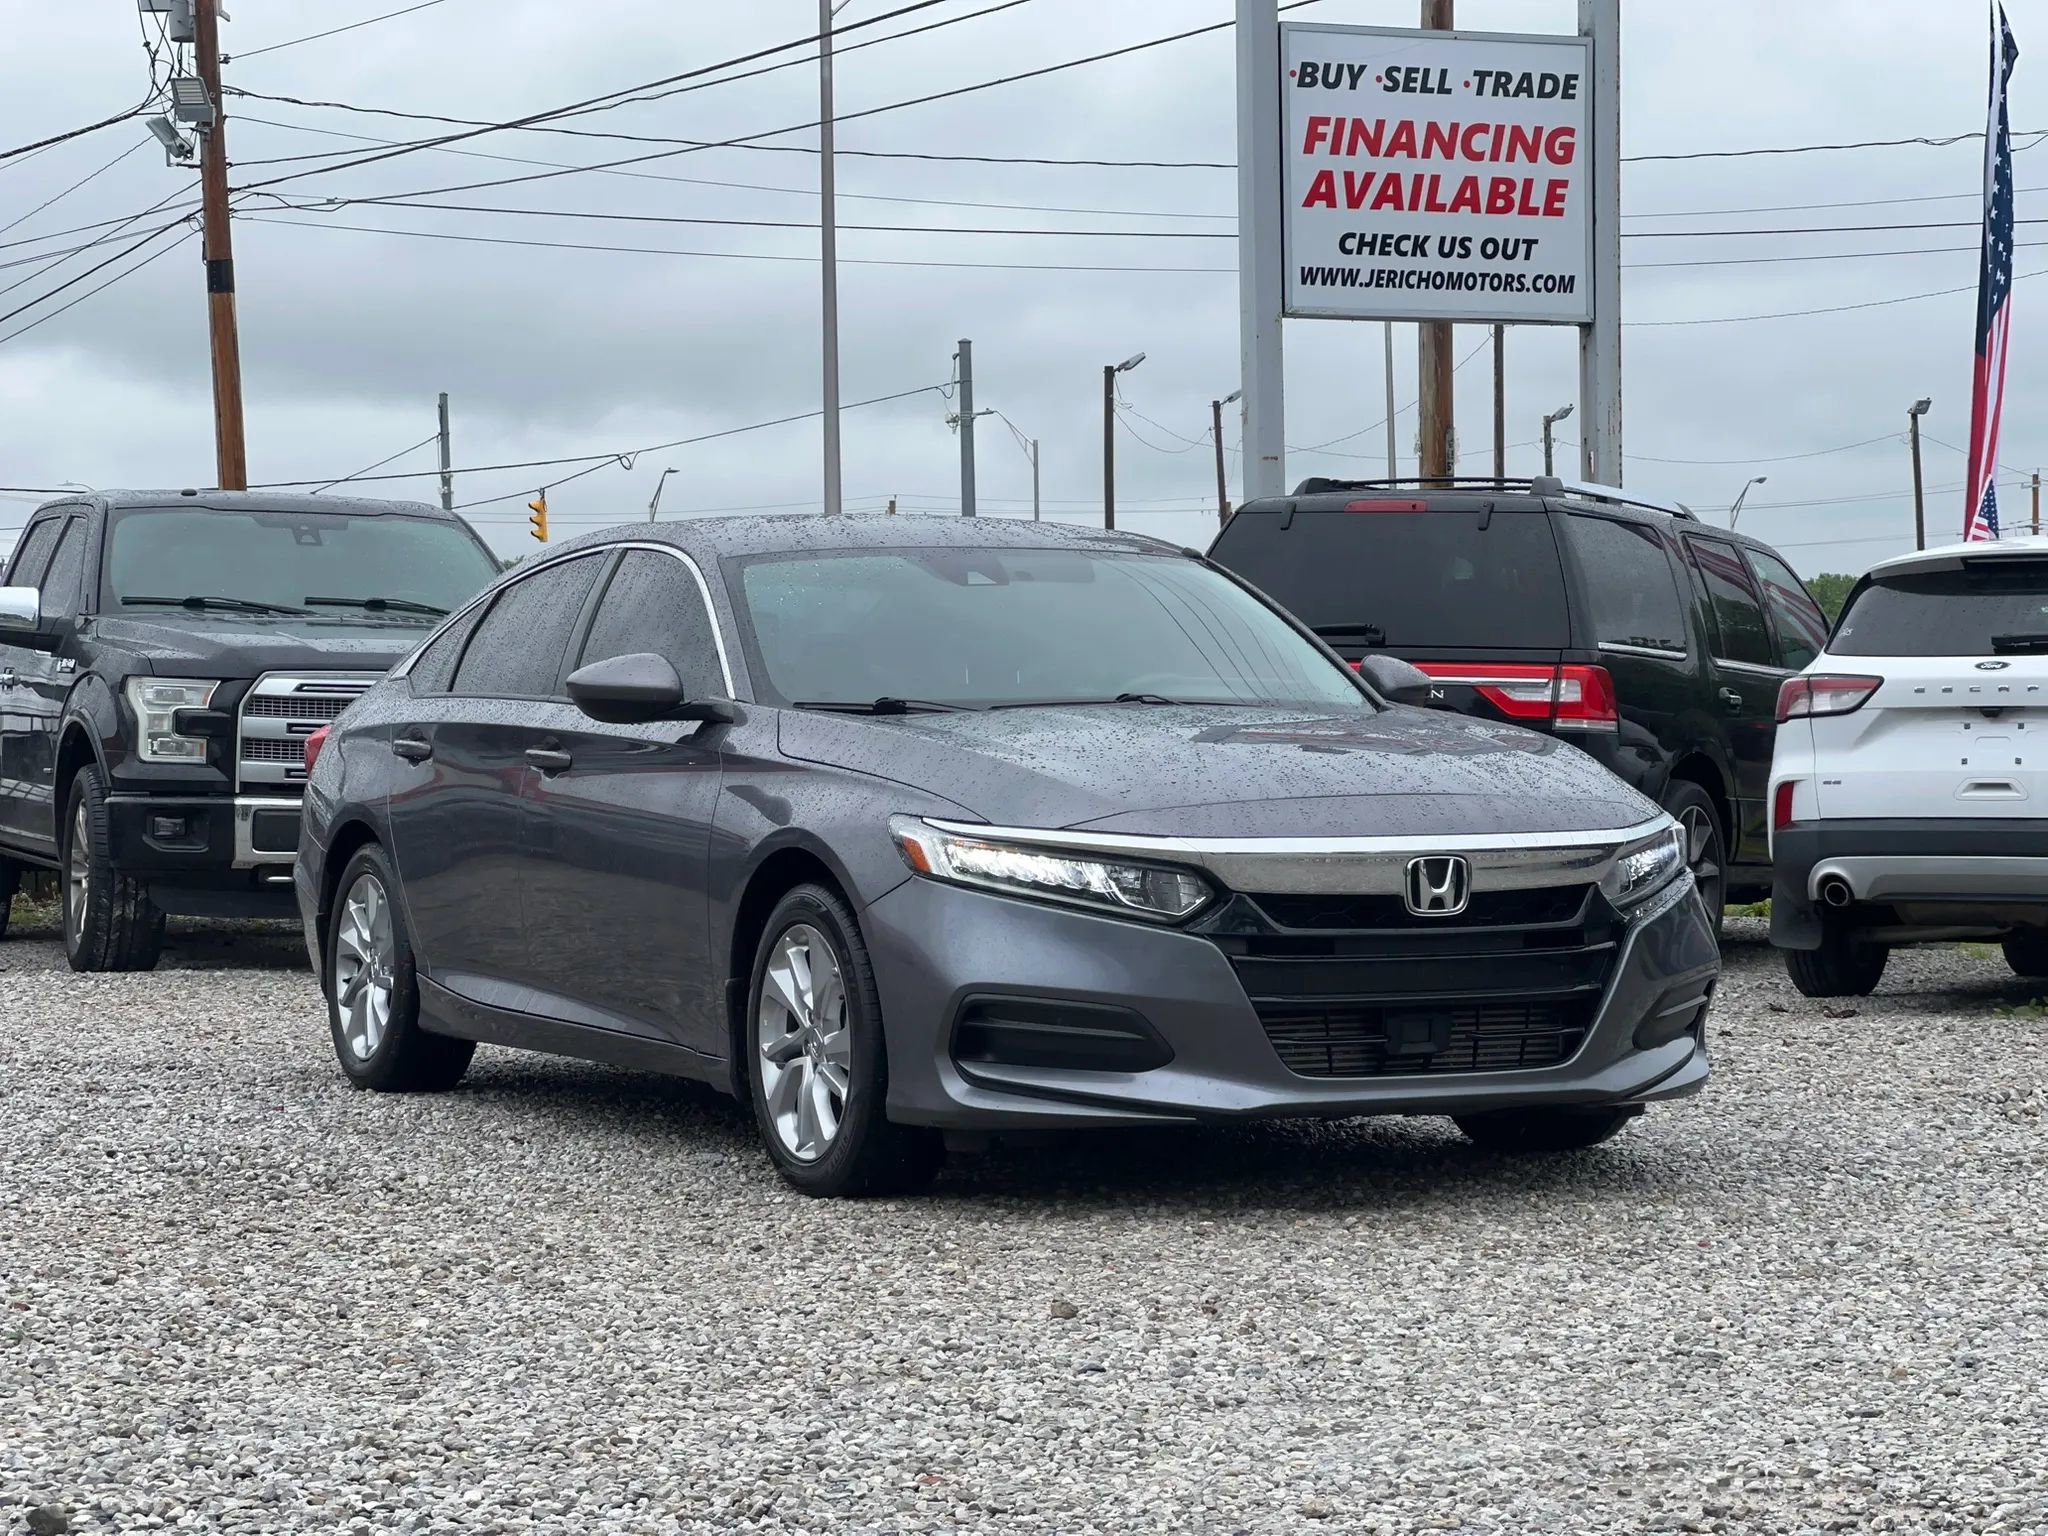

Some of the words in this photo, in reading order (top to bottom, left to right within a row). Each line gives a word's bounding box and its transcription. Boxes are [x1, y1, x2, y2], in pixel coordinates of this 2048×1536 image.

[1297, 61, 1367, 91] BUY
[1383, 65, 1453, 95] SELL
[1473, 70, 1579, 100] TRADE
[1303, 115, 1576, 165] FINANCING
[1302, 169, 1569, 217] AVAILABLE
[1338, 232, 1431, 258] CHECK
[1438, 235, 1473, 259] US
[1480, 237, 1539, 261] OUT
[1300, 266, 1575, 294] WWW.JERICHOMOTORS.COM
